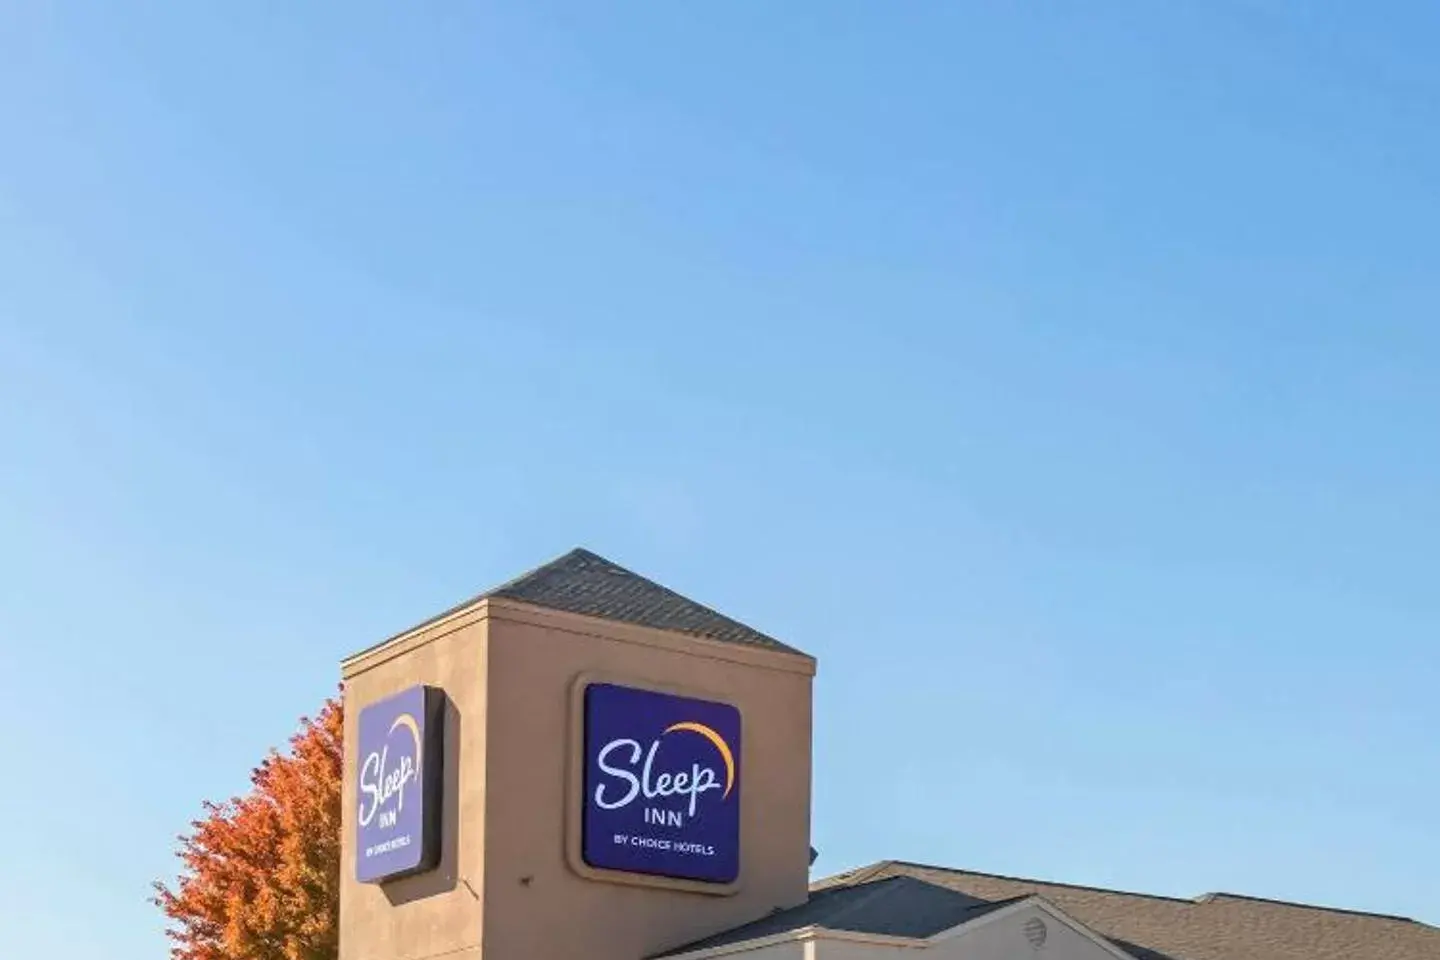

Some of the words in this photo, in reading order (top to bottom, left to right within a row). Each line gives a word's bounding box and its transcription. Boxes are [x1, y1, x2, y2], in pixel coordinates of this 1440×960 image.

[358, 743, 414, 827] Sleep
[594, 738, 721, 817] Sleep
[644, 807, 682, 828] INN
[613, 833, 629, 845] BY
[631, 836, 671, 850] CHOICE
[673, 841, 715, 856] HOTELS
